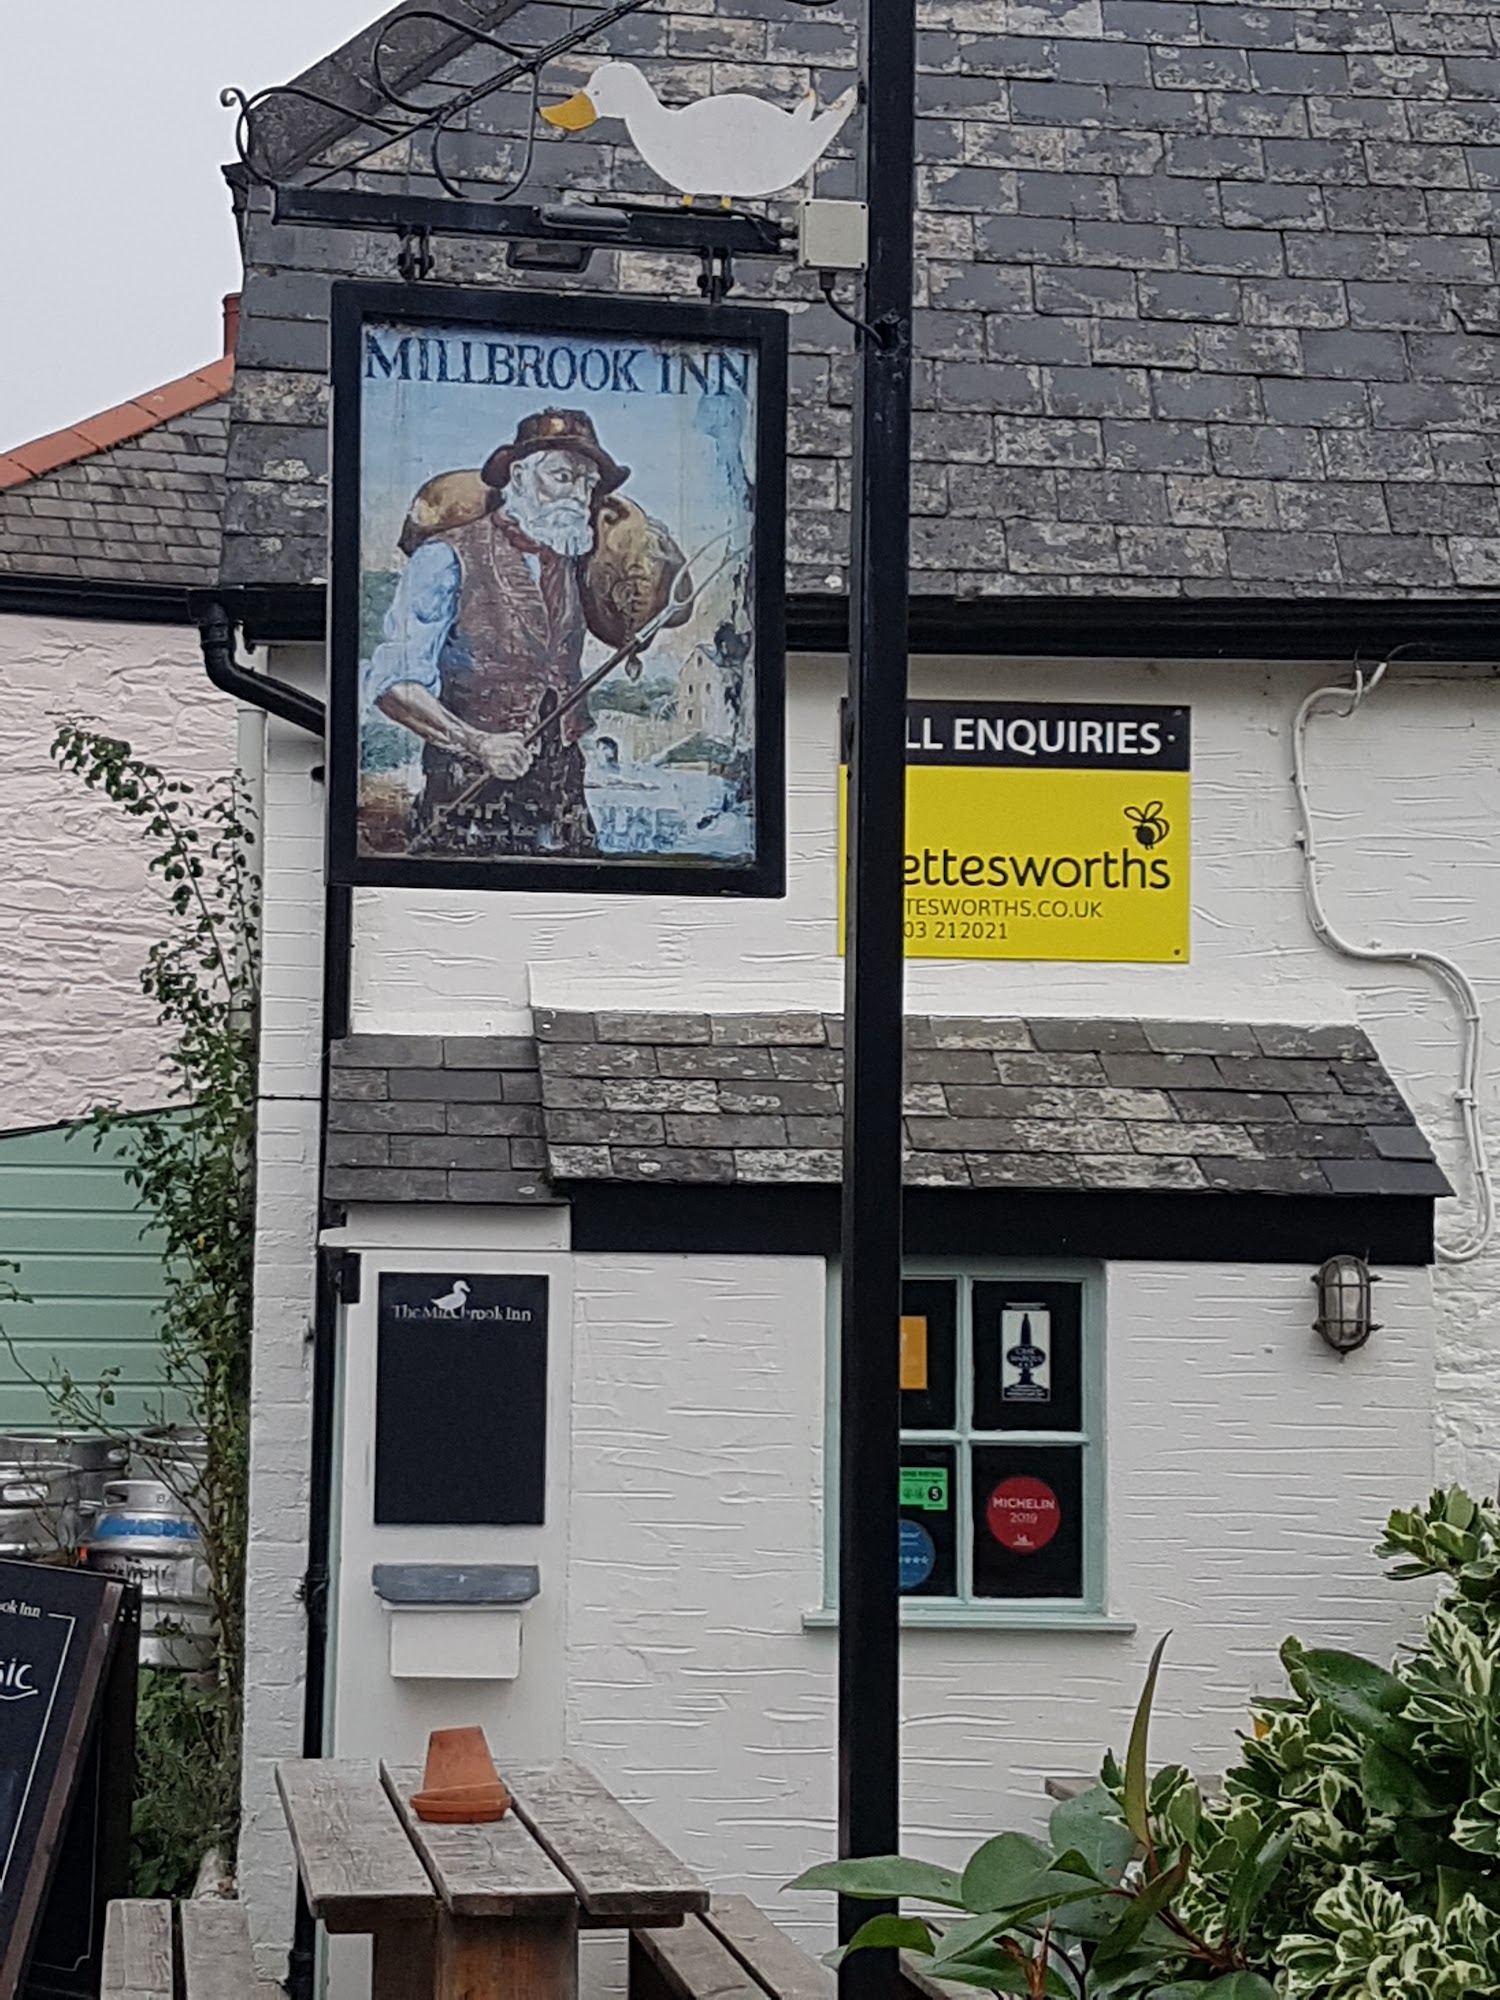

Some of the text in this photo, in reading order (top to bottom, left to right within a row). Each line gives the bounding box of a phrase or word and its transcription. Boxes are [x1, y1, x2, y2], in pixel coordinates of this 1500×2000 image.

[365, 328, 750, 396] MILLBROOK INN
[905, 716, 1162, 756] LL ENQUIRIES
[903, 848, 1171, 889] ettesworths
[904, 898, 1104, 919] TESWORTHS.CO.UK
[903, 920, 1008, 940] 03 212021
[391, 1303, 420, 1319] The
[504, 1305, 532, 1321] Inn
[993, 1496, 1056, 1510] MICHELIN
[1009, 1512, 1038, 1525] 2019
[19, 1602, 41, 1618] Inn
[0, 1658, 33, 1690] ic
